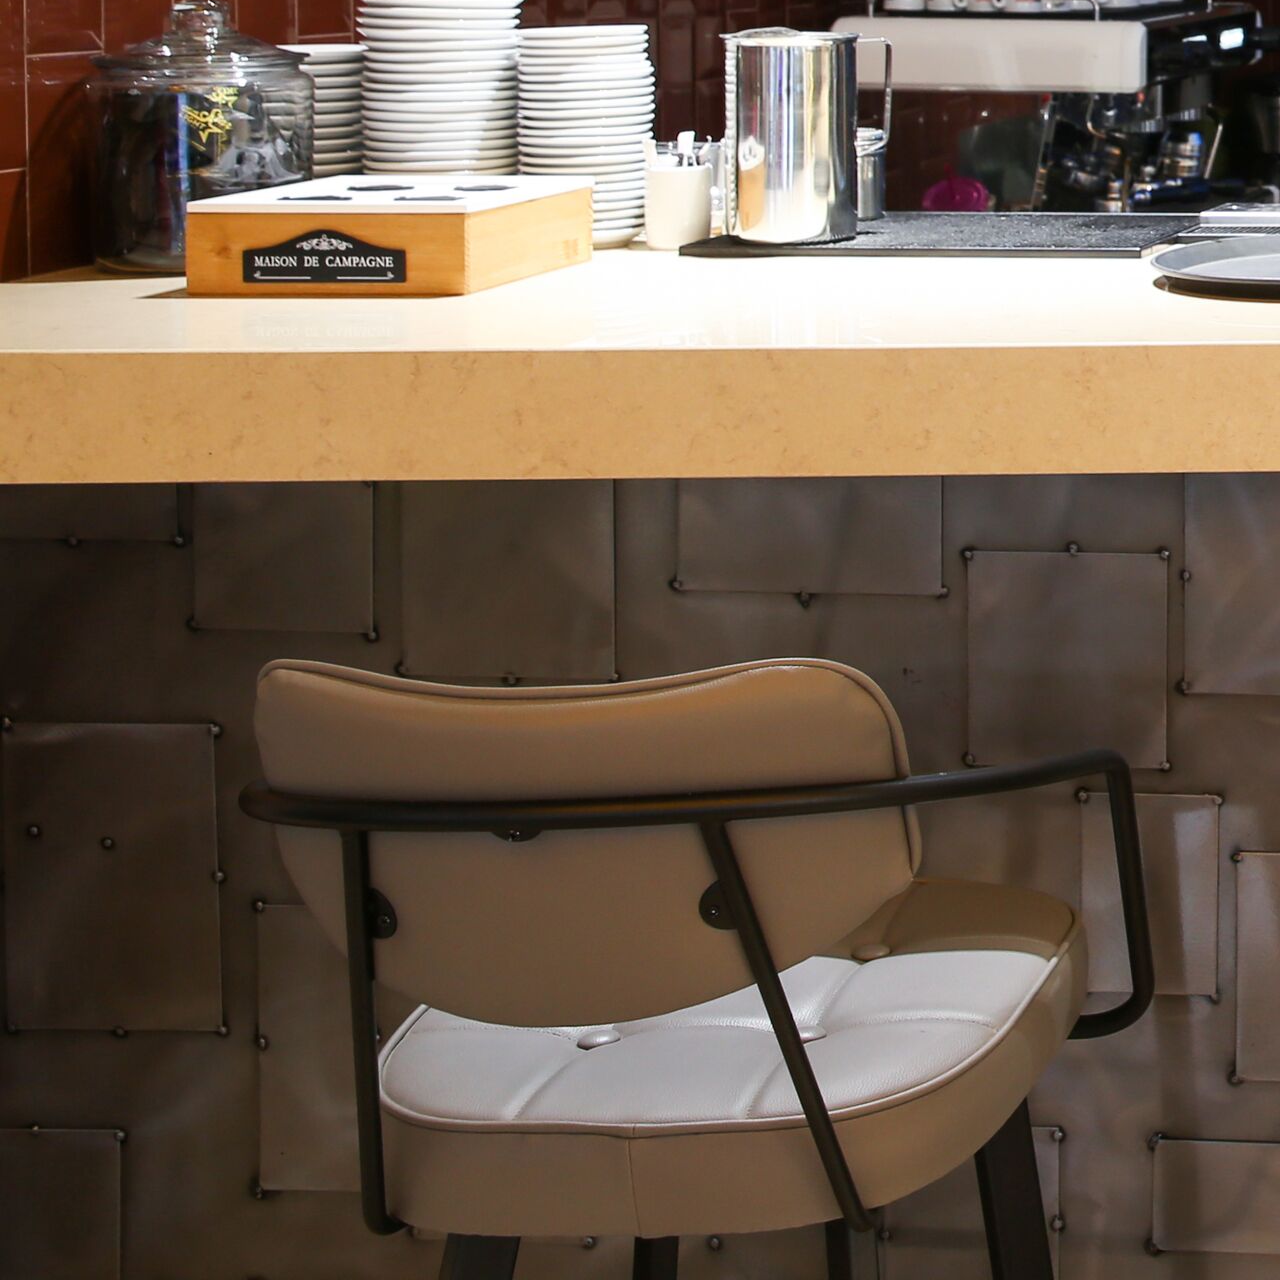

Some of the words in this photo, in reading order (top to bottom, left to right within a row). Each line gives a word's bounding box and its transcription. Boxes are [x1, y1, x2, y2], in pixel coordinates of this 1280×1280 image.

[254, 255, 297, 267] MAISON
[304, 256, 319, 267] DE
[325, 256, 394, 268] CAMPAGNE
